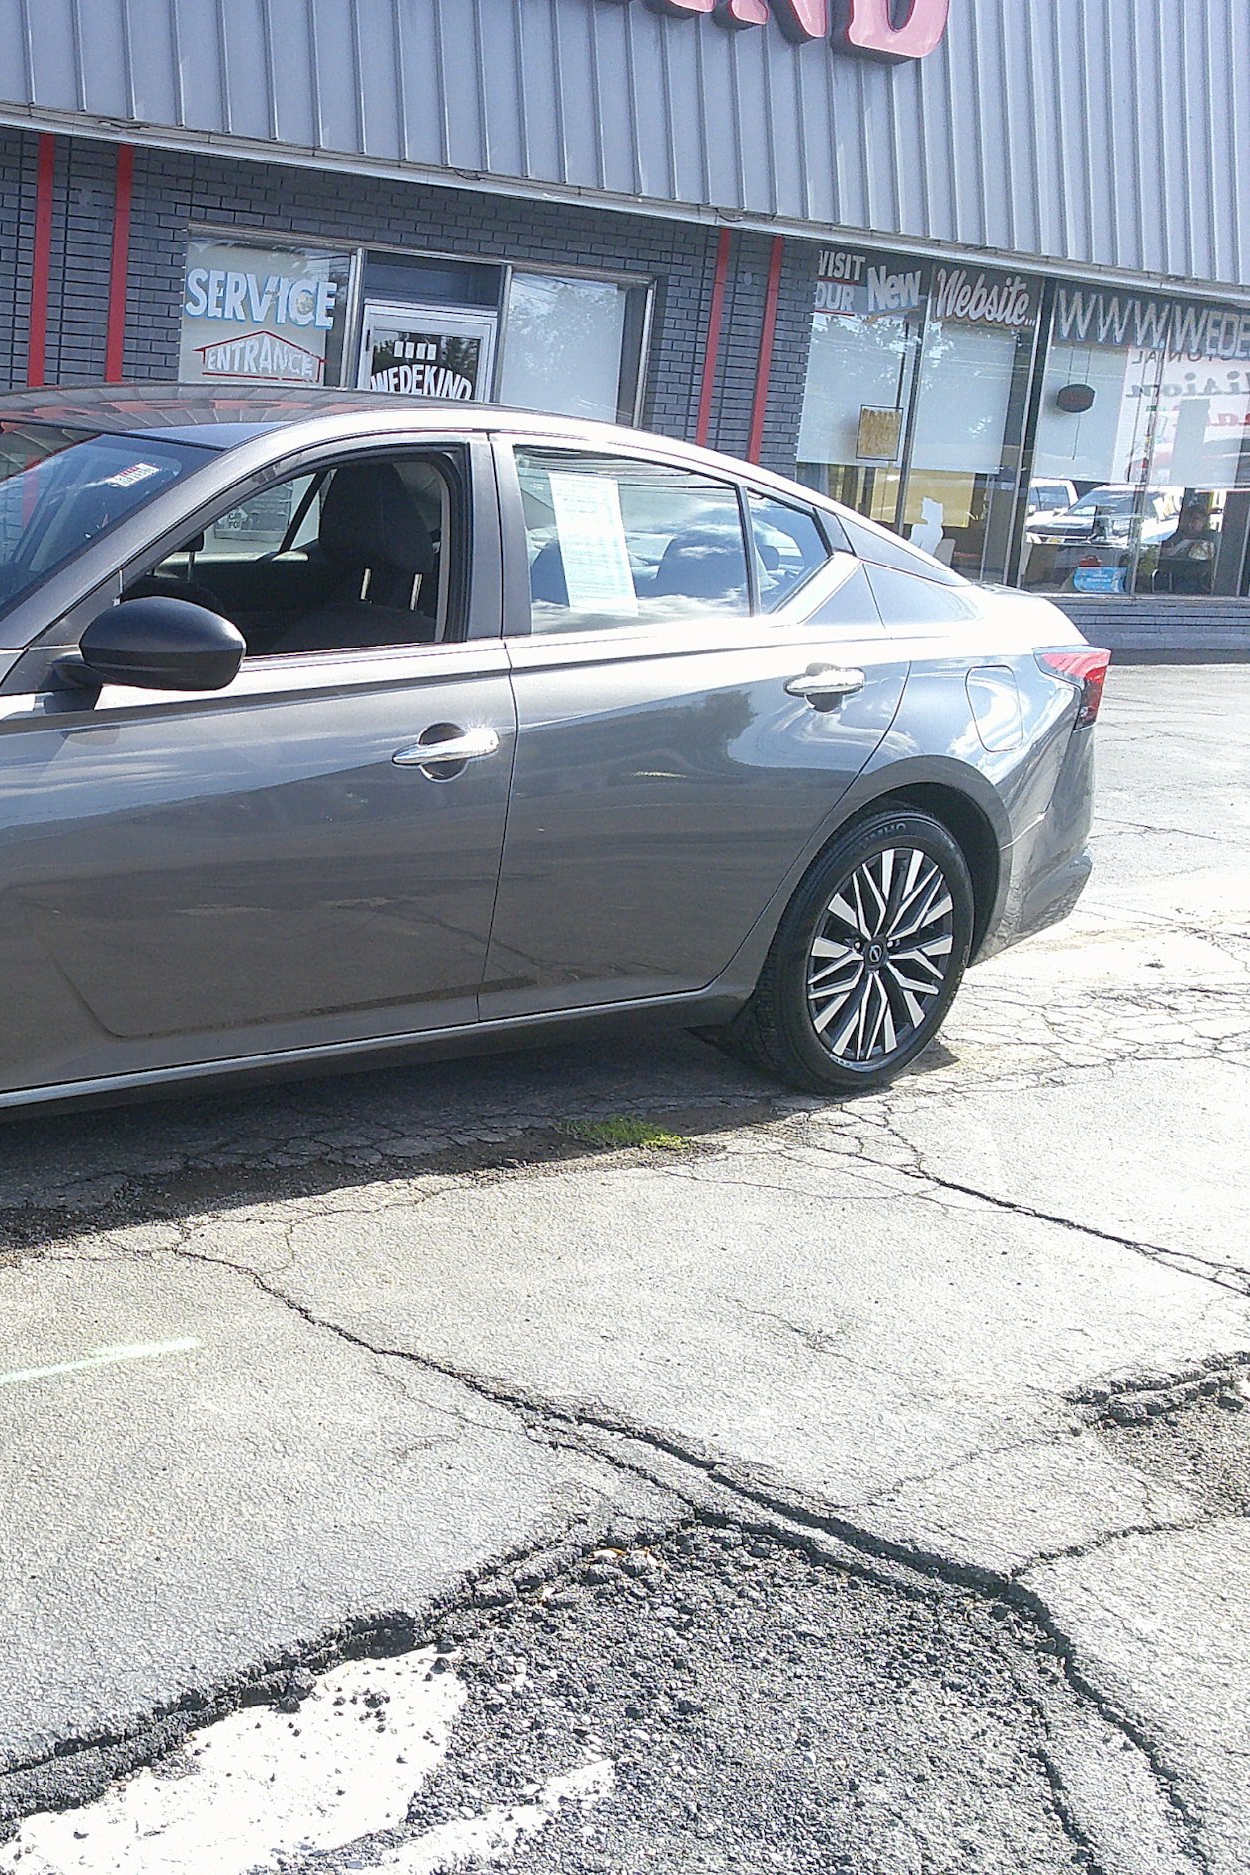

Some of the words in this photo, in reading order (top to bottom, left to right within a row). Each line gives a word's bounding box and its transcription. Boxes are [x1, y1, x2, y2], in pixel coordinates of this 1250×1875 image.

[817, 250, 866, 281] VISIT
[185, 268, 338, 331] SERVICE
[814, 281, 855, 311] OUR
[867, 265, 921, 312] New
[207, 335, 313, 377] ENTRANCE
[370, 364, 472, 400] WEDEKIND
